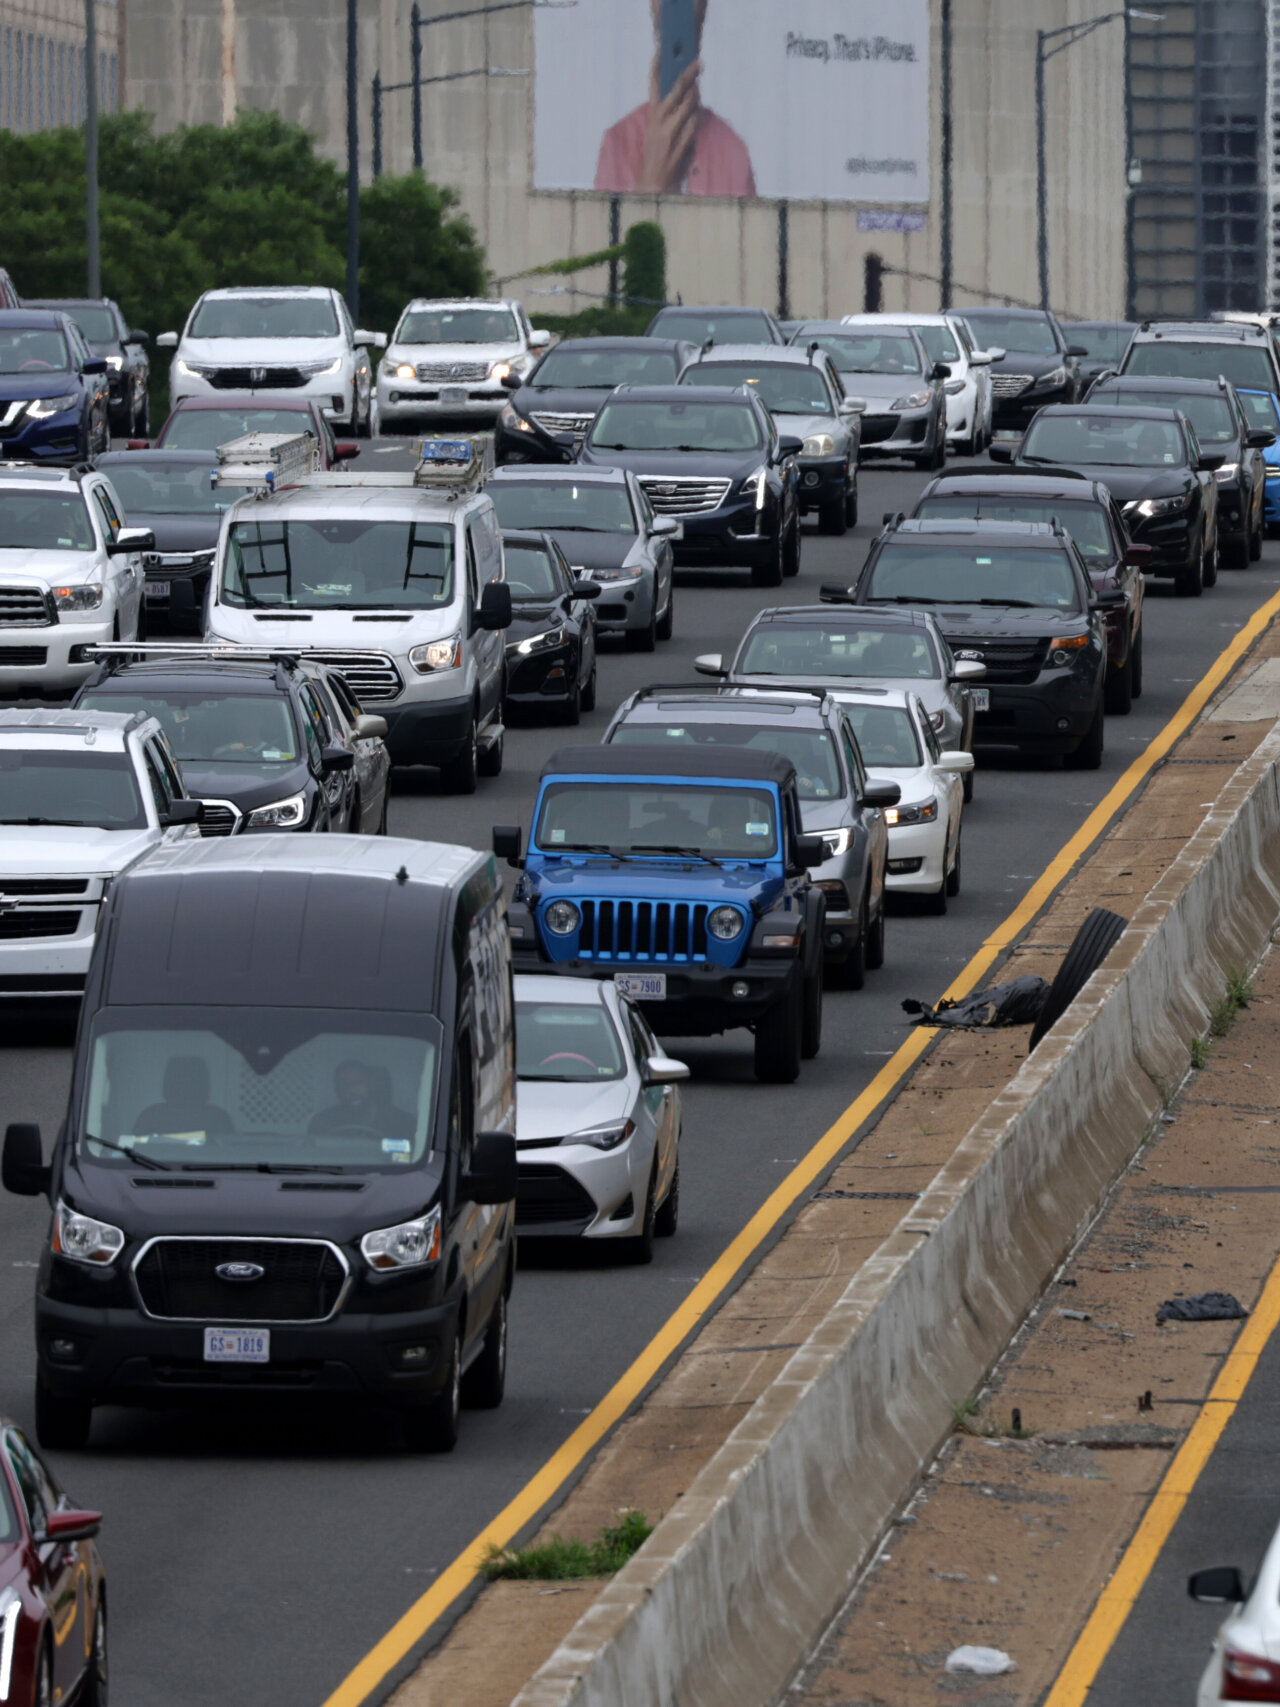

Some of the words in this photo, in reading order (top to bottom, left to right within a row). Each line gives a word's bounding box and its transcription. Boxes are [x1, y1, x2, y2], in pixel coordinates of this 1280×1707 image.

[226, 1264, 253, 1276] Ford
[210, 1336, 225, 1353] GS
[236, 1337, 264, 1353] 1819
